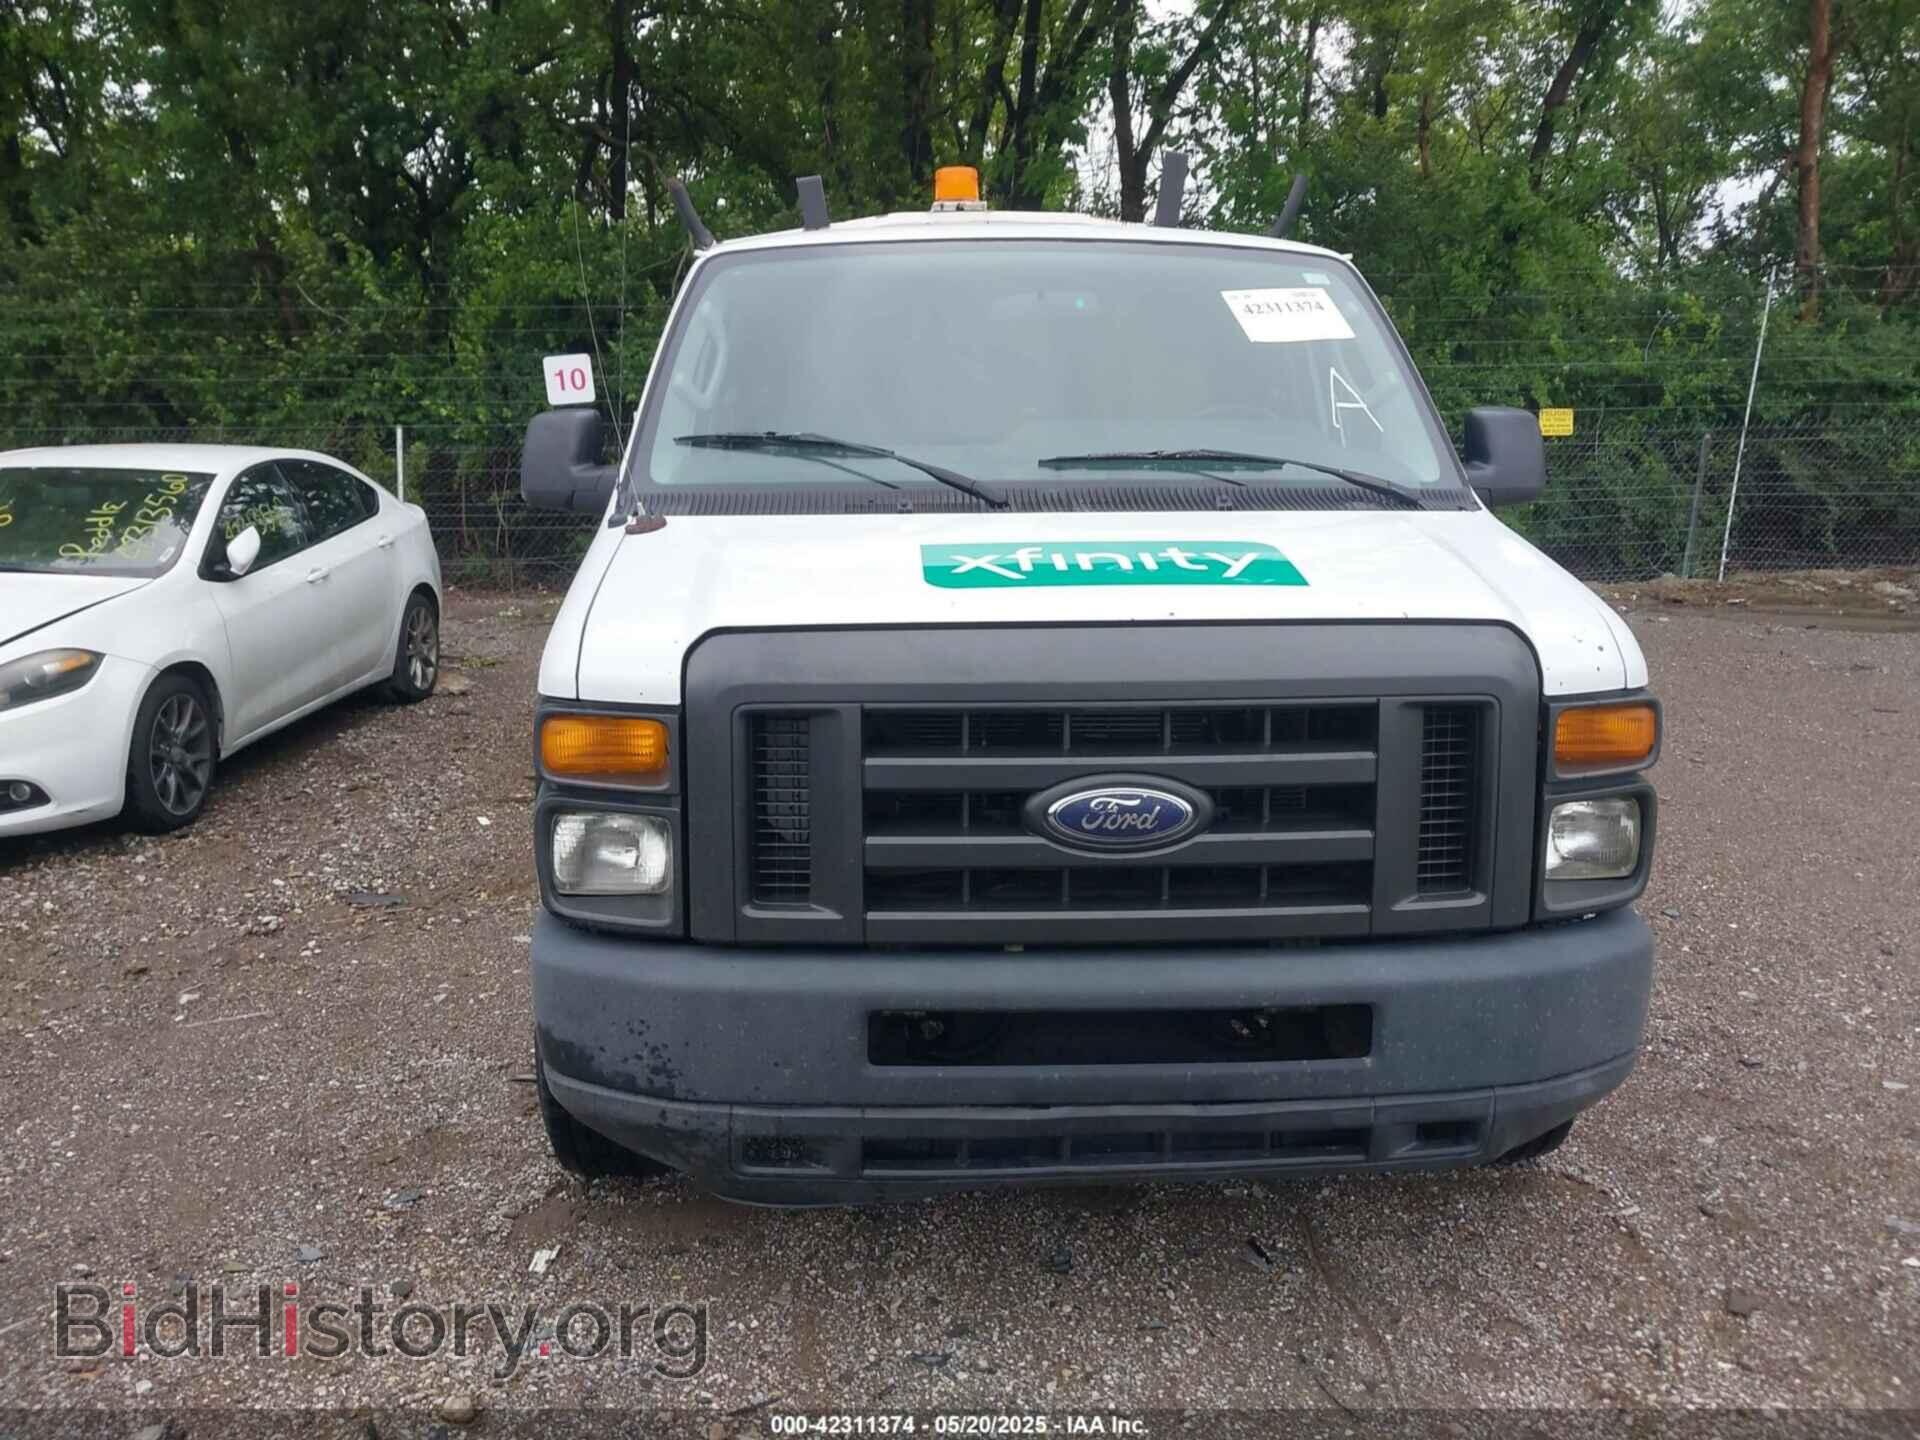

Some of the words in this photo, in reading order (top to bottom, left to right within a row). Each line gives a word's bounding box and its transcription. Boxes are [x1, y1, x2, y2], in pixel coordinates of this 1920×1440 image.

[1243, 301, 1326, 315] 42311374
[554, 368, 586, 391] 10
[1329, 366, 1384, 446] A
[949, 546, 1260, 580] xfinity
[1081, 796, 1161, 830] Ford
